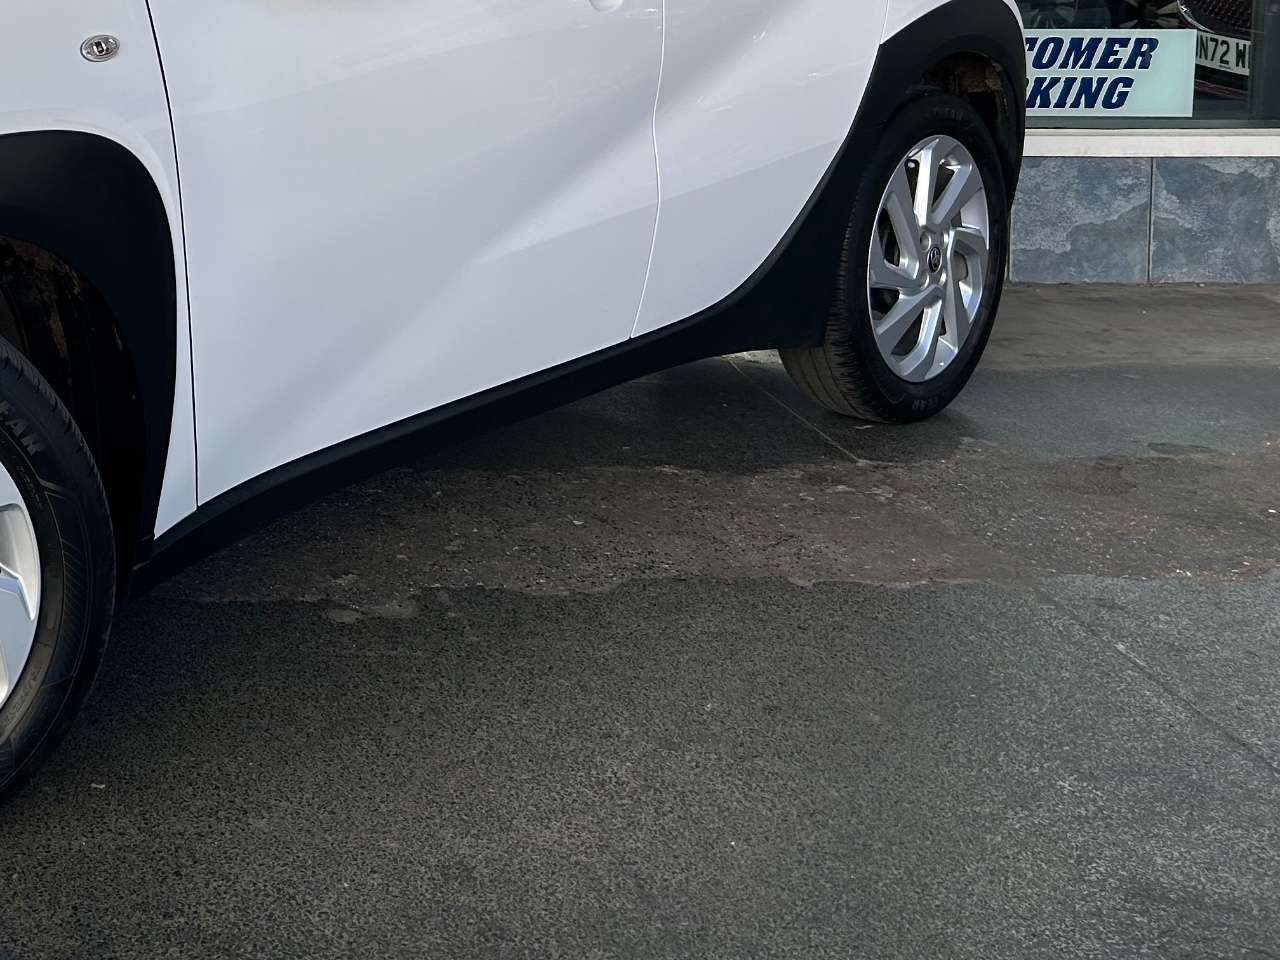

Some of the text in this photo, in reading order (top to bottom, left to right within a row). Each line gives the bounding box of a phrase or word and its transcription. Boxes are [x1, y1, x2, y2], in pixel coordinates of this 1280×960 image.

[1024, 36, 1159, 71] OMER
[1196, 32, 1250, 69] N72 W
[1025, 76, 1134, 110] KING
